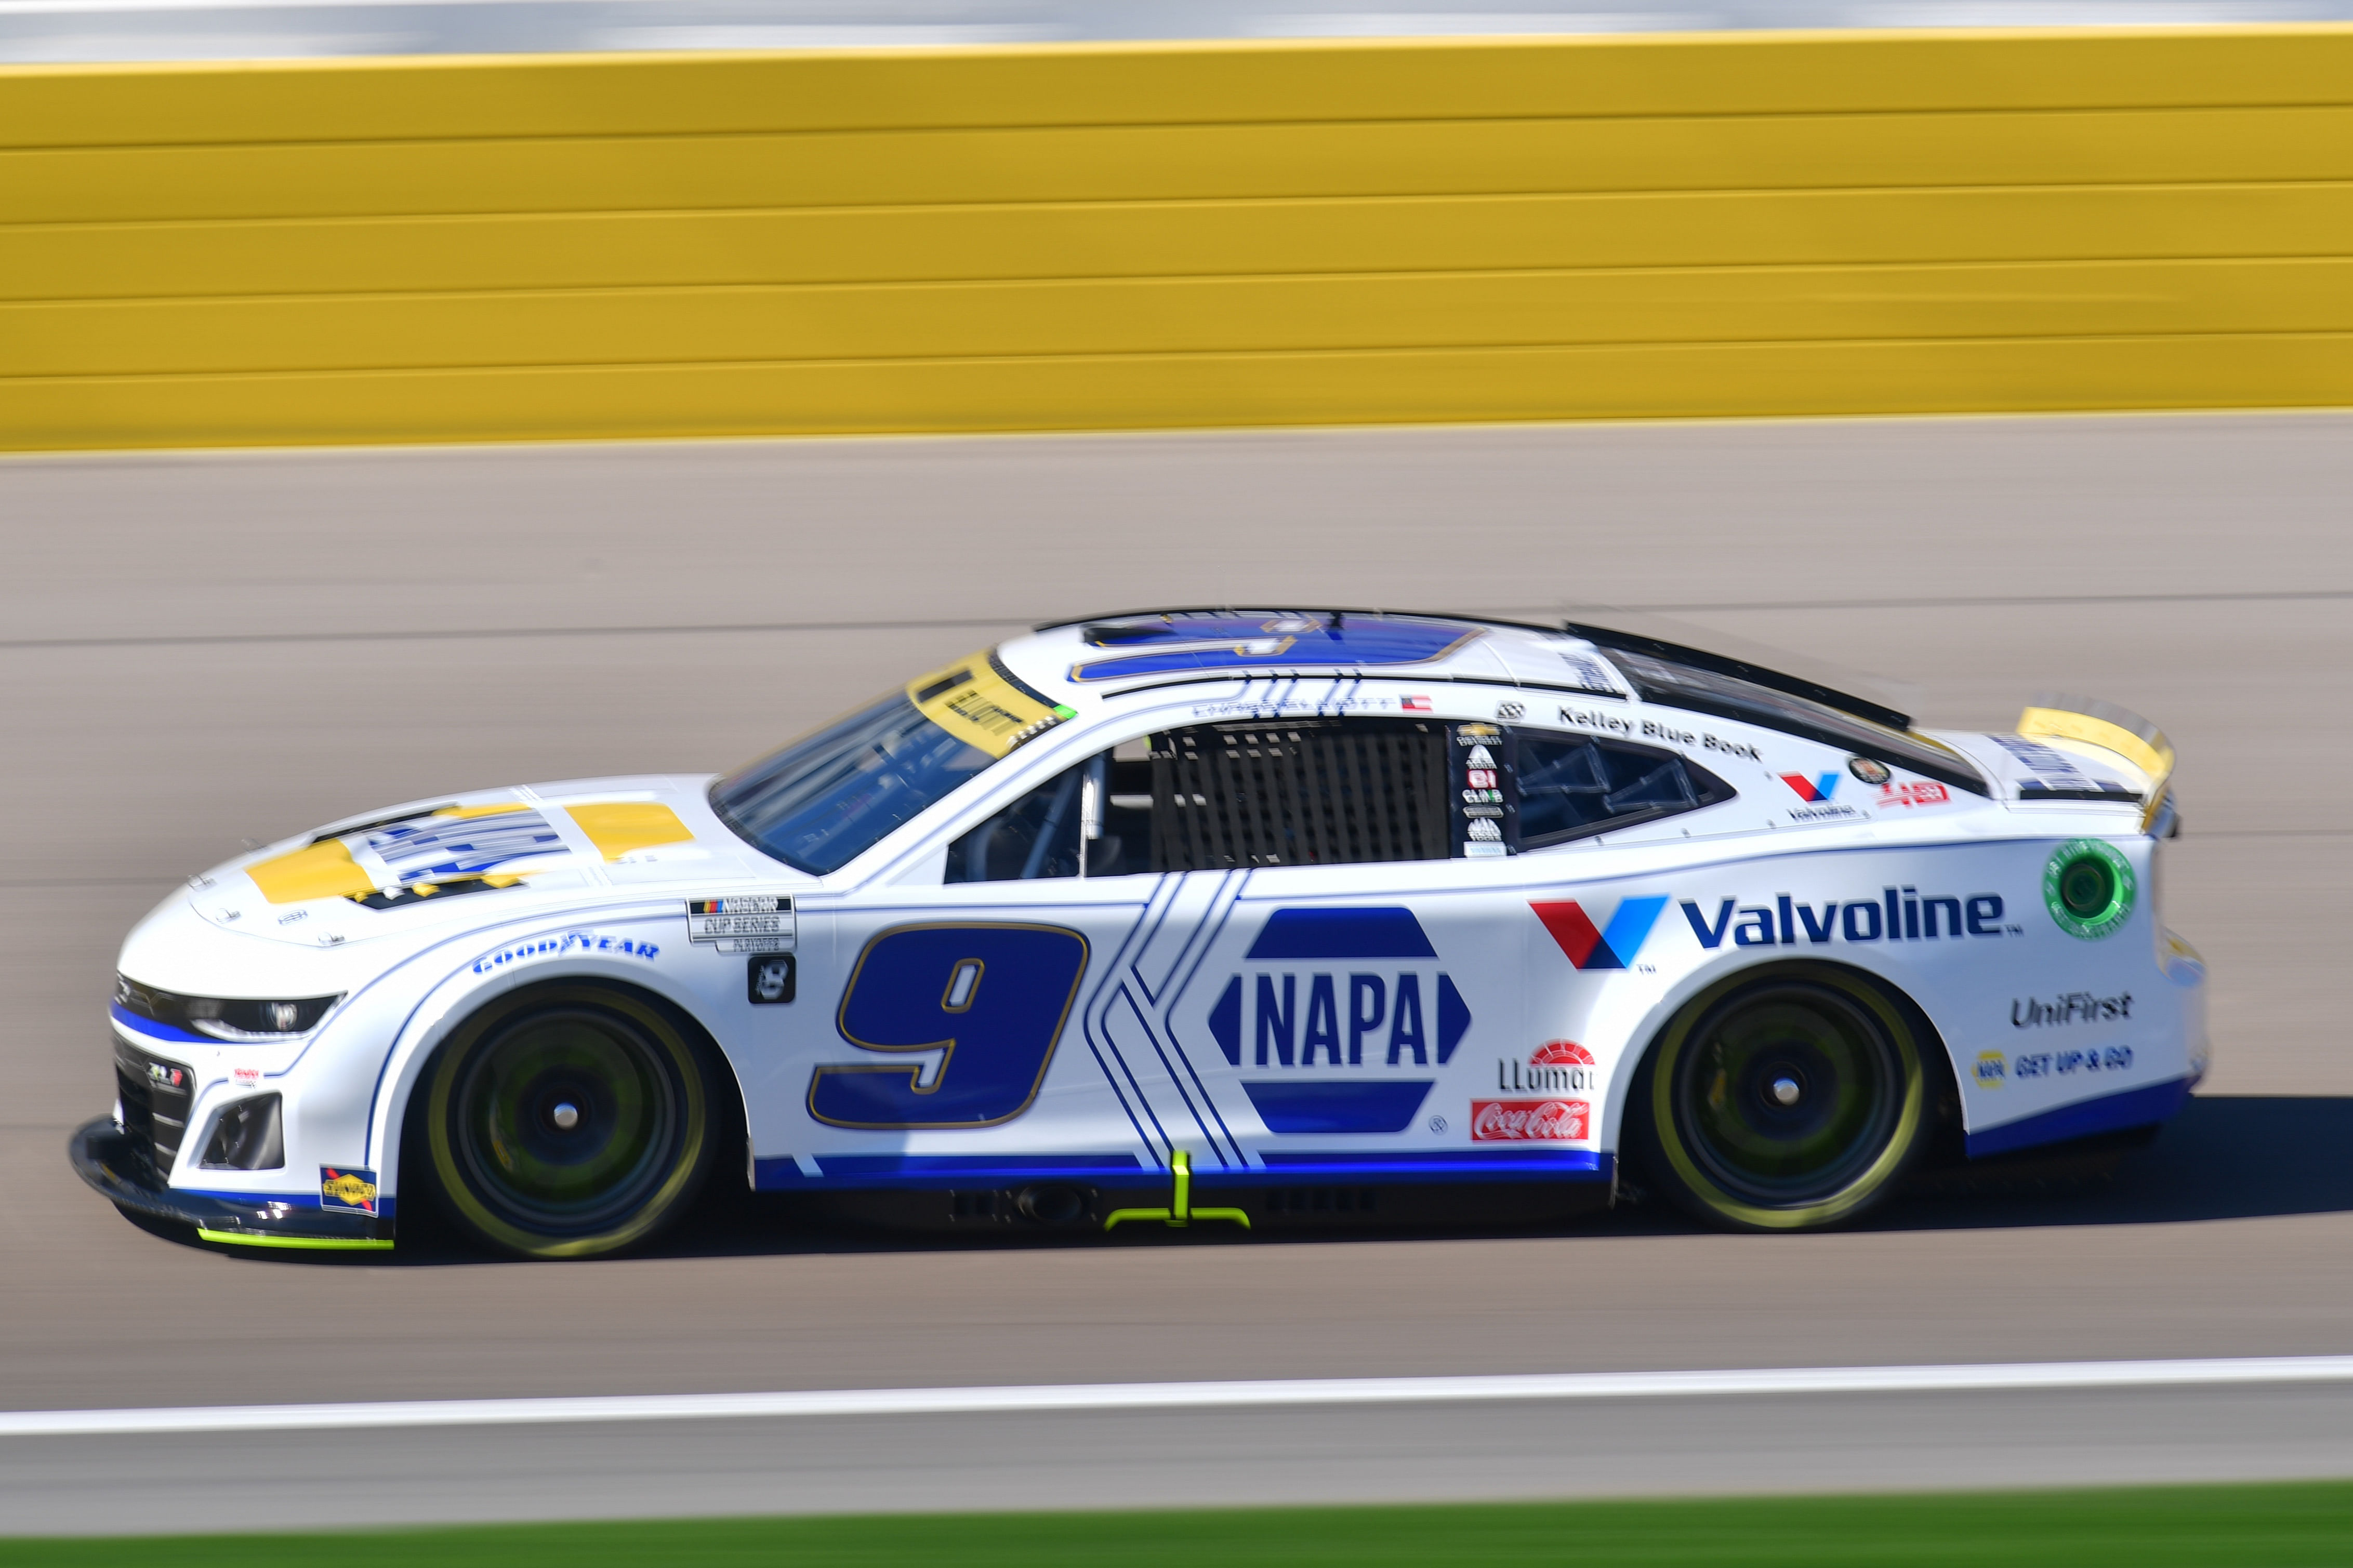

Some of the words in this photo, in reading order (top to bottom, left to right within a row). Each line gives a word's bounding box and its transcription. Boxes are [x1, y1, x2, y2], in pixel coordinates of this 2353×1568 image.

[1558, 705, 1635, 738] Kelley
[1641, 719, 1697, 746] Blue
[1702, 732, 1763, 763] Book
[705, 918, 731, 934] CUP
[733, 916, 780, 933] SERIES
[1677, 884, 2004, 950] Valvoline
[472, 929, 660, 975] GOODYEAR
[806, 920, 1091, 1131] 9
[1255, 972, 1428, 1066] NAPA
[2012, 991, 2134, 1030] UniFirst
[2015, 1052, 2053, 1079] GET
[2056, 1049, 2083, 1075] UP
[2085, 1048, 2101, 1072] &
[2104, 1045, 2133, 1070] GO
[1474, 1102, 1589, 1140] Coca-Cola
